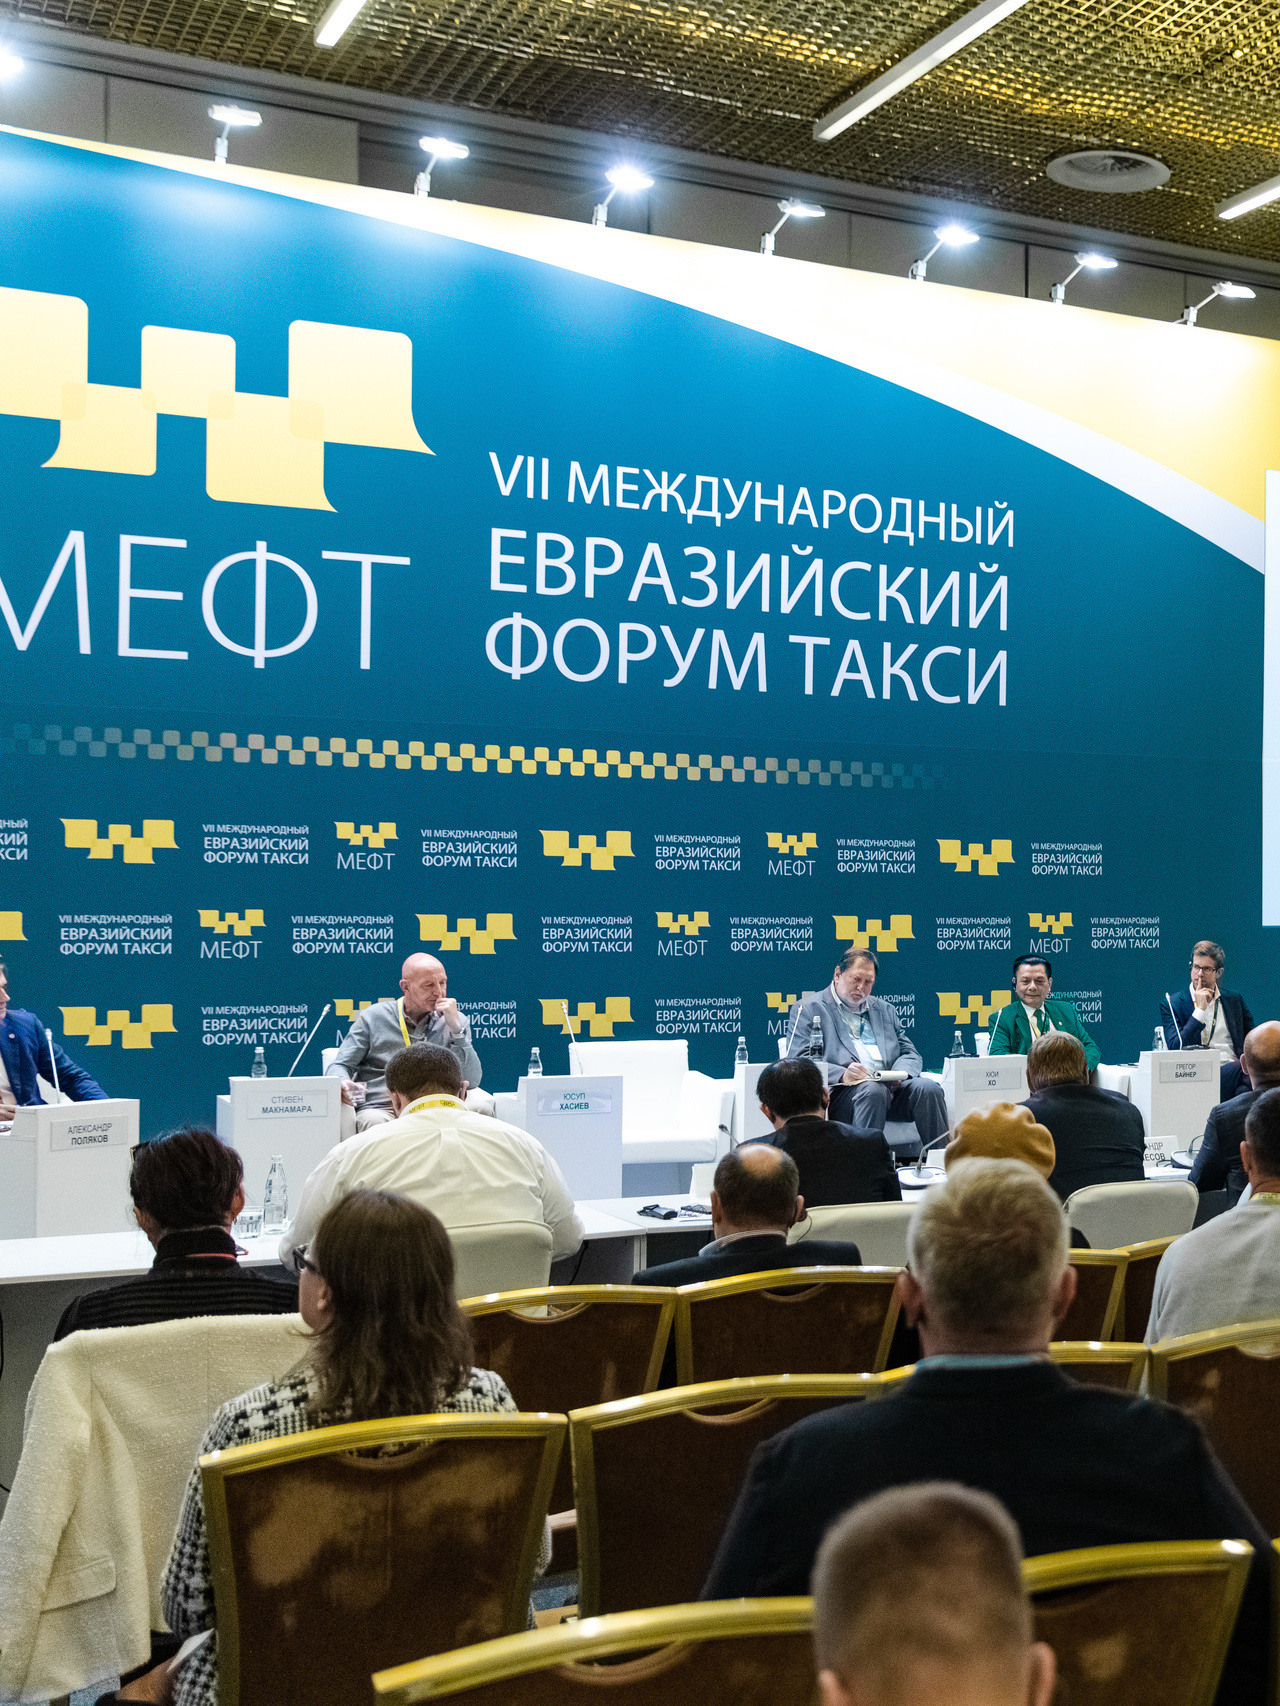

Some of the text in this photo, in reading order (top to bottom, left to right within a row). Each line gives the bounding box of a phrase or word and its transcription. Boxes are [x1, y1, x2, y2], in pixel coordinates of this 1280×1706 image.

[489, 452, 1015, 548] VII МЕЖДУНАРОДНЫЙ
[490, 527, 1008, 631] ЕВРАЗИЙСКИЙ
[0, 530, 411, 670] МЕФТ
[485, 612, 1007, 707] ФОРУМ ТАКСИ
[216, 824, 310, 835] МЕЖДУНАРОДНЫЙ
[433, 829, 518, 840] МЕЖДУНАРОДНЫЙ
[203, 835, 309, 851] ЕВРАЗИЙСКИЙ
[665, 834, 741, 845] МЕЖДУНАРОДНЫЙ
[846, 838, 916, 849] МЕЖДУНАРОДНЫЙ
[422, 840, 518, 855] ЕВРАЗИЙСКИЙ
[655, 845, 741, 859] ЕВРАЗИЙСКИЙ
[1040, 842, 1103, 852] МЕЖДУНАРОДНЫЙ
[203, 850, 309, 865] ФОРУМ ТАКСИ
[421, 854, 518, 868] ФОРУМ ТАКСИ
[837, 848, 916, 862] ЕВРАЗИЙСКИЙ
[1031, 852, 1103, 864] ЕВРАЗИЙСКИЙ
[336, 852, 396, 872] МЕФТ
[654, 858, 741, 871] ФОРУМ ТАКСИ
[768, 860, 816, 877] МЕФТ
[836, 861, 916, 874] ФОРУМ ТАКСИ
[1031, 864, 1103, 876] ФОРУМ ТАКСИ
[73, 913, 173, 925] МЕЖДУНАРОДНЫЙ
[304, 914, 394, 926] МЕЖДУНАРОДНЫЙ
[553, 915, 633, 926] МЕЖДУНАРОДНЫЙ
[740, 915, 813, 926] МЕЖДУНАРОДНЫЙ
[945, 916, 1012, 926] МЕЖДУНАРОДНЫЙ
[1099, 916, 1160, 925] МЕЖДУНАРОДНЫЙ
[60, 925, 173, 941] ЕВРАЗИЙСКИЙ
[292, 926, 394, 940] ЕВРАЗИЙСКИЙ
[542, 926, 633, 940] ЕВРАЗИЙСКИЙ
[730, 926, 813, 940] ЕВРАЗИЙСКИЙ
[936, 926, 1011, 939] ЕВРАЗИЙСКИЙ
[1091, 925, 1160, 938] ЕВРАЗИЙСКИЙ
[59, 942, 173, 956] ФОРУМ ТАКСИ
[200, 940, 263, 960] МЕФТ
[291, 941, 394, 955] ФОРУМ ТАКСИ
[541, 940, 633, 953] ФОРУМ ТАКСИ
[657, 940, 709, 957] МЕФТ
[730, 940, 813, 952] ФОРУМ ТАКСИ
[936, 939, 1011, 951] ФОРУМ ТАКСИ
[1029, 938, 1072, 954] МЕФТ
[1090, 938, 1160, 950] ФОРУМ ТАКСИ
[457, 1000, 517, 1011] УНАРОДНЫЙ
[666, 996, 742, 1008] МЕЖДУНАРОДНЫЙ
[215, 1003, 308, 1016] МЕЖДУНАРОДНЫЙ
[656, 1007, 742, 1022] ЕВРАЗИЙСКИЙ
[202, 1015, 308, 1032] ЕВРАЗИЙСКИЙ
[1076, 1013, 1102, 1023] АКСИ
[473, 1027, 517, 1039] ТАКСИ
[655, 1021, 741, 1035] ФОРУМ ТАКСИ
[201, 1031, 308, 1046] ФОРУМ ТАКСИ
[1175, 1063, 1197, 1071] ГРЕГОР
[1174, 1071, 1197, 1079] БАЙНЕР
[271, 1095, 304, 1105] СТИВЕН
[563, 1092, 586, 1101] ЮСУП
[261, 1104, 313, 1115] МАКНАМАРА
[559, 1102, 590, 1111] ХАСИЕВ
[67, 1122, 113, 1135] АЛЕКСАНДР
[70, 1134, 109, 1147] ПОЛЯКОВ
